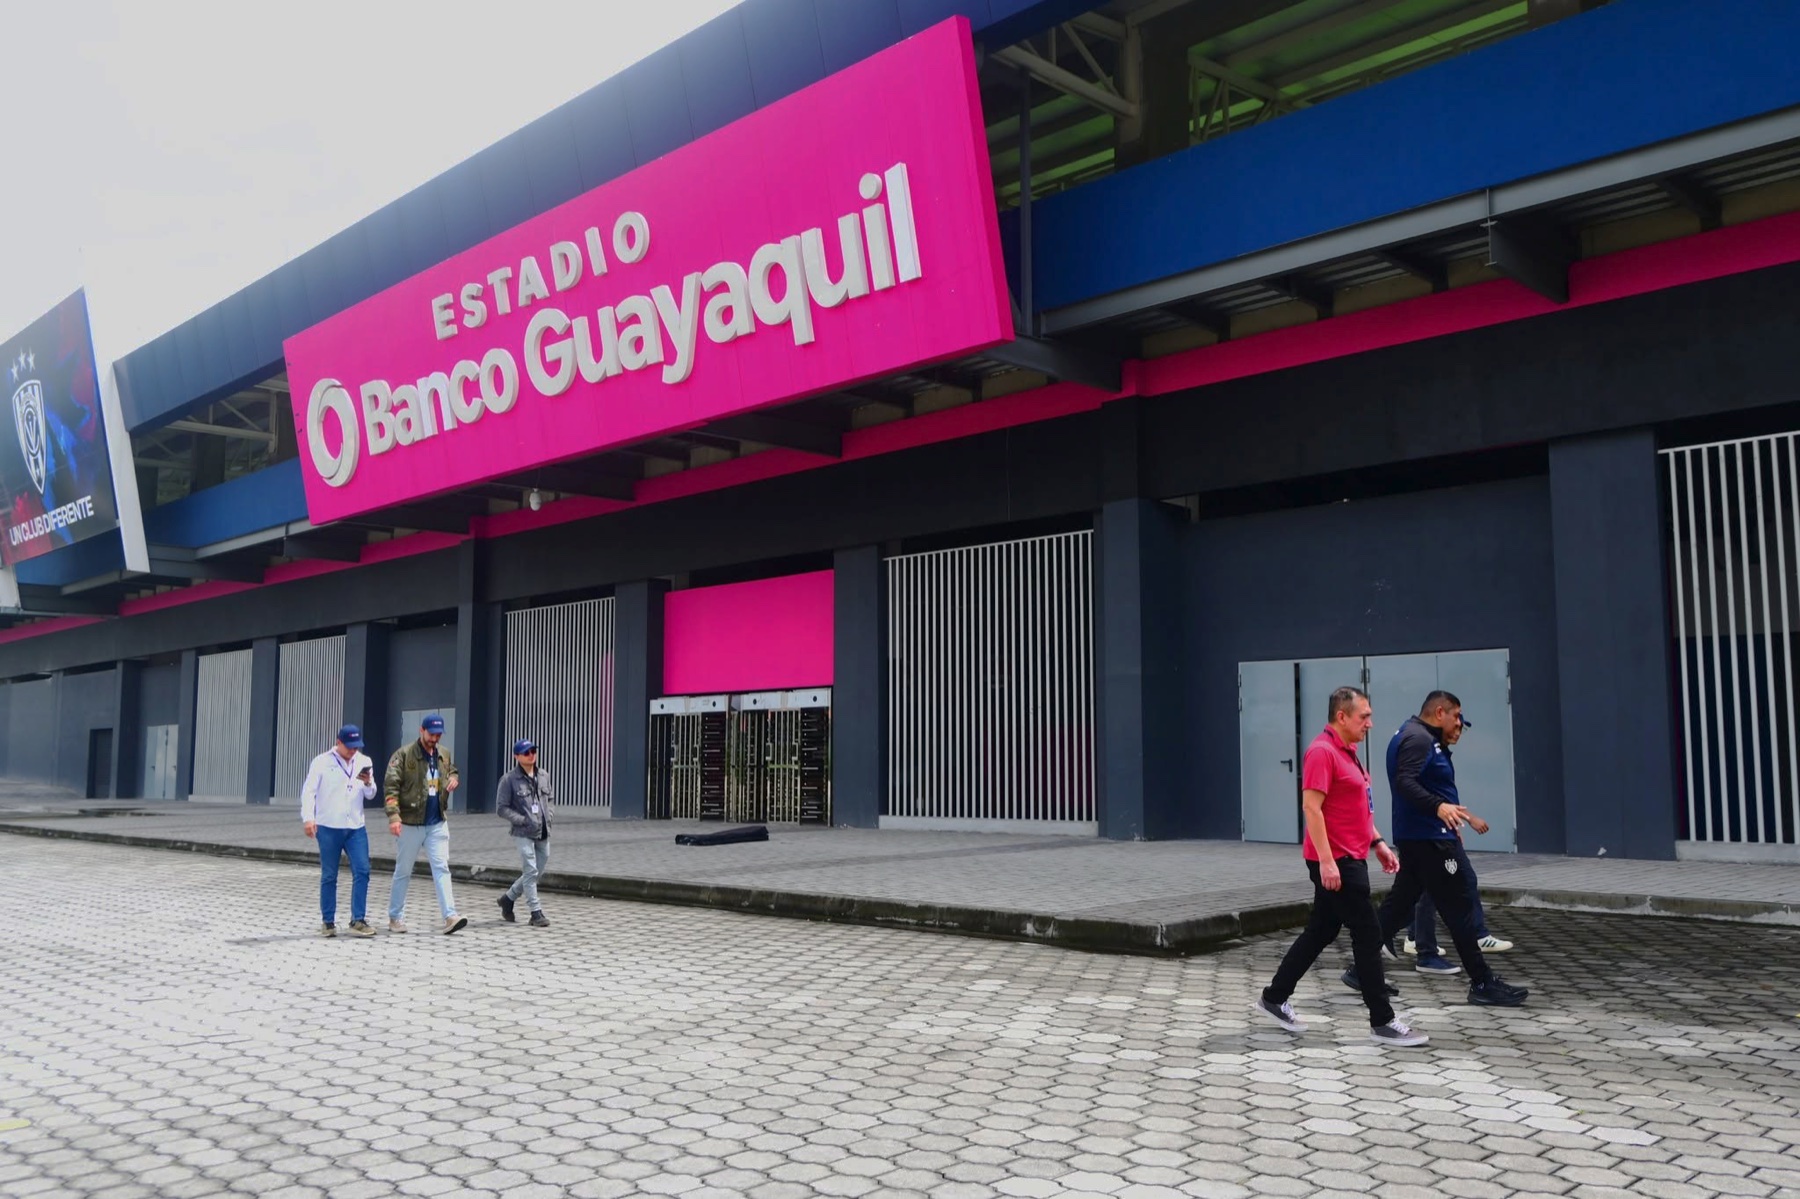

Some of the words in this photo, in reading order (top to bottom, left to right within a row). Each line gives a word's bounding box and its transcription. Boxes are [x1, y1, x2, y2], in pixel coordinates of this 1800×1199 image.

[360, 348, 519, 456] Banco
[524, 162, 922, 396] Guayaquil
[431, 211, 650, 340] ESTADIO
[9, 526, 23, 546] UN
[20, 516, 45, 541] CLUB
[42, 495, 95, 533] DIFERENTE
